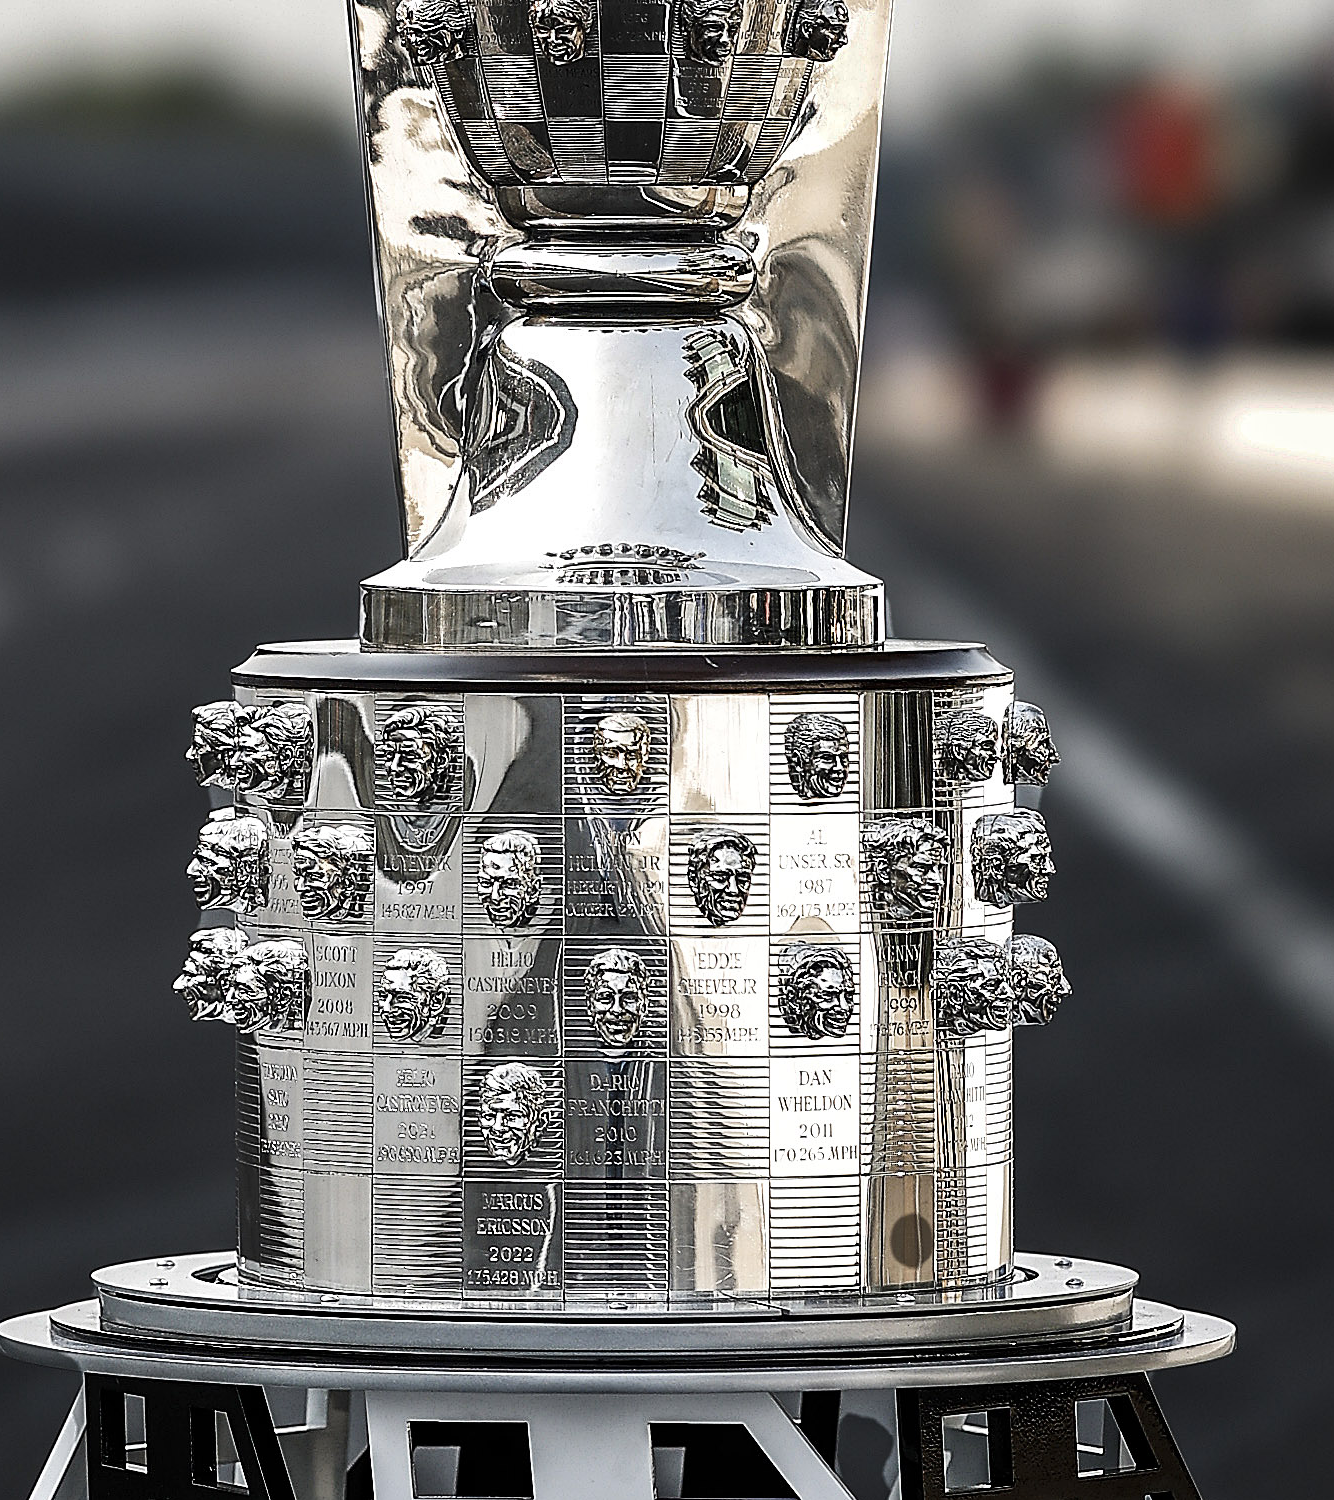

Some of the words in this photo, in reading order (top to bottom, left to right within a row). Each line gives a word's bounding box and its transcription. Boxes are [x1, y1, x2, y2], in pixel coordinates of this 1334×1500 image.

[806, 829, 827, 845] AL
[397, 881, 435, 896] 1997
[798, 879, 833, 895] 1987
[381, 903, 421, 920] 145.827
[777, 903, 822, 918] 162.175
[315, 945, 357, 963] SCOTT
[491, 951, 534, 968] HELIO
[697, 952, 743, 970] EDDIE
[315, 972, 357, 989] DIXON
[467, 976, 559, 995] CASTRONEVES
[317, 999, 354, 1015] 2008
[487, 1004, 538, 1020] 2009
[699, 1003, 741, 1019] 1998
[469, 1025, 521, 1044] 150.318
[396, 1068, 436, 1087] HELIO
[590, 1073, 640, 1092] DARIO
[798, 1069, 833, 1087] DAN
[376, 1093, 459, 1114] CASTRONEVES
[567, 1098, 666, 1117] FRANCHITTI
[778, 1094, 852, 1113] WHELDON
[397, 1122, 436, 1140] 2021
[594, 1126, 637, 1142] 2010
[798, 1122, 834, 1139] 2011
[569, 1150, 623, 1166] 161.623
[773, 1147, 825, 1163] 170.265
[482, 1192, 544, 1210] MARCUS
[476, 1217, 551, 1236] ERICSSON
[489, 1246, 534, 1262] 2022
[467, 1269, 519, 1285] 175.428
